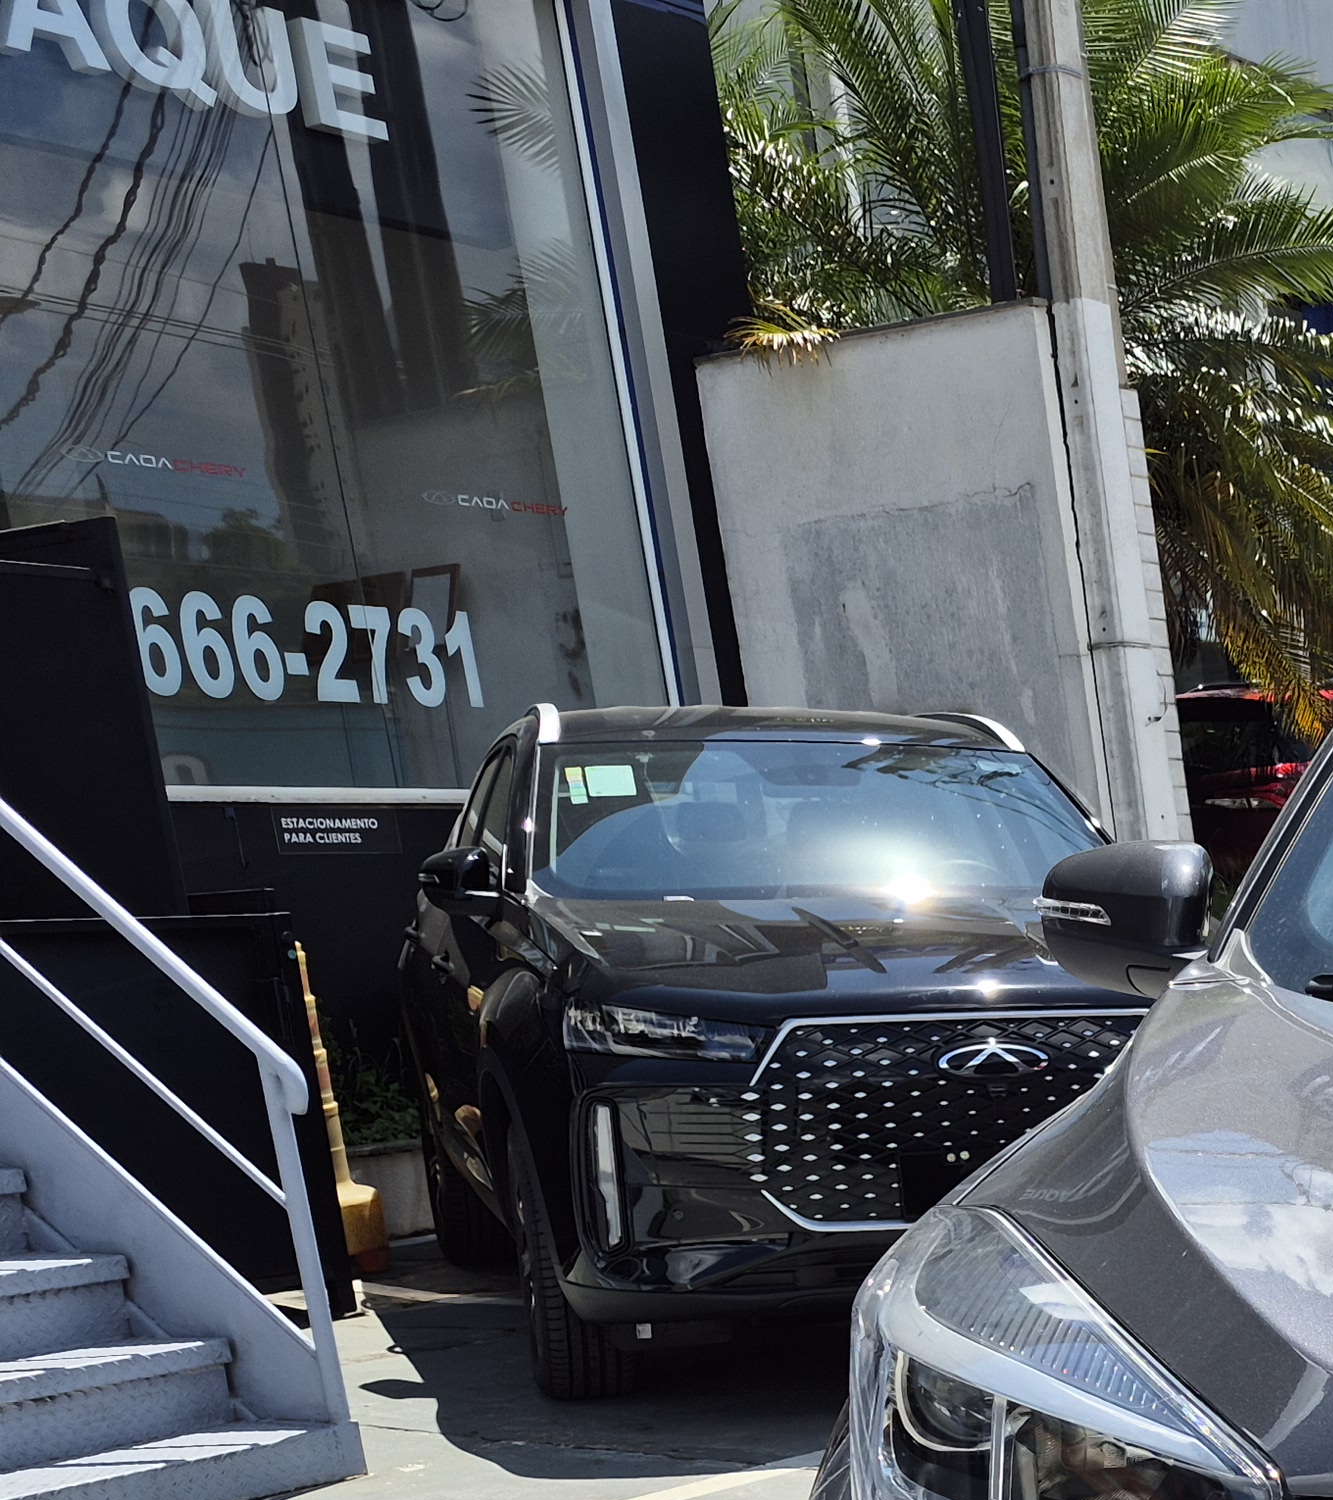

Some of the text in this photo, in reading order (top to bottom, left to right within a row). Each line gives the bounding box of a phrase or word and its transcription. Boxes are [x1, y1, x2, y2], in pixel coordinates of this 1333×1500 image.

[173, 459, 247, 477] CHERY
[511, 501, 568, 517] CHERY
[128, 586, 485, 708] 666-2731
[280, 817, 379, 829] ESTACIONAMENTO
[284, 832, 362, 843] PARA CLIENTES
